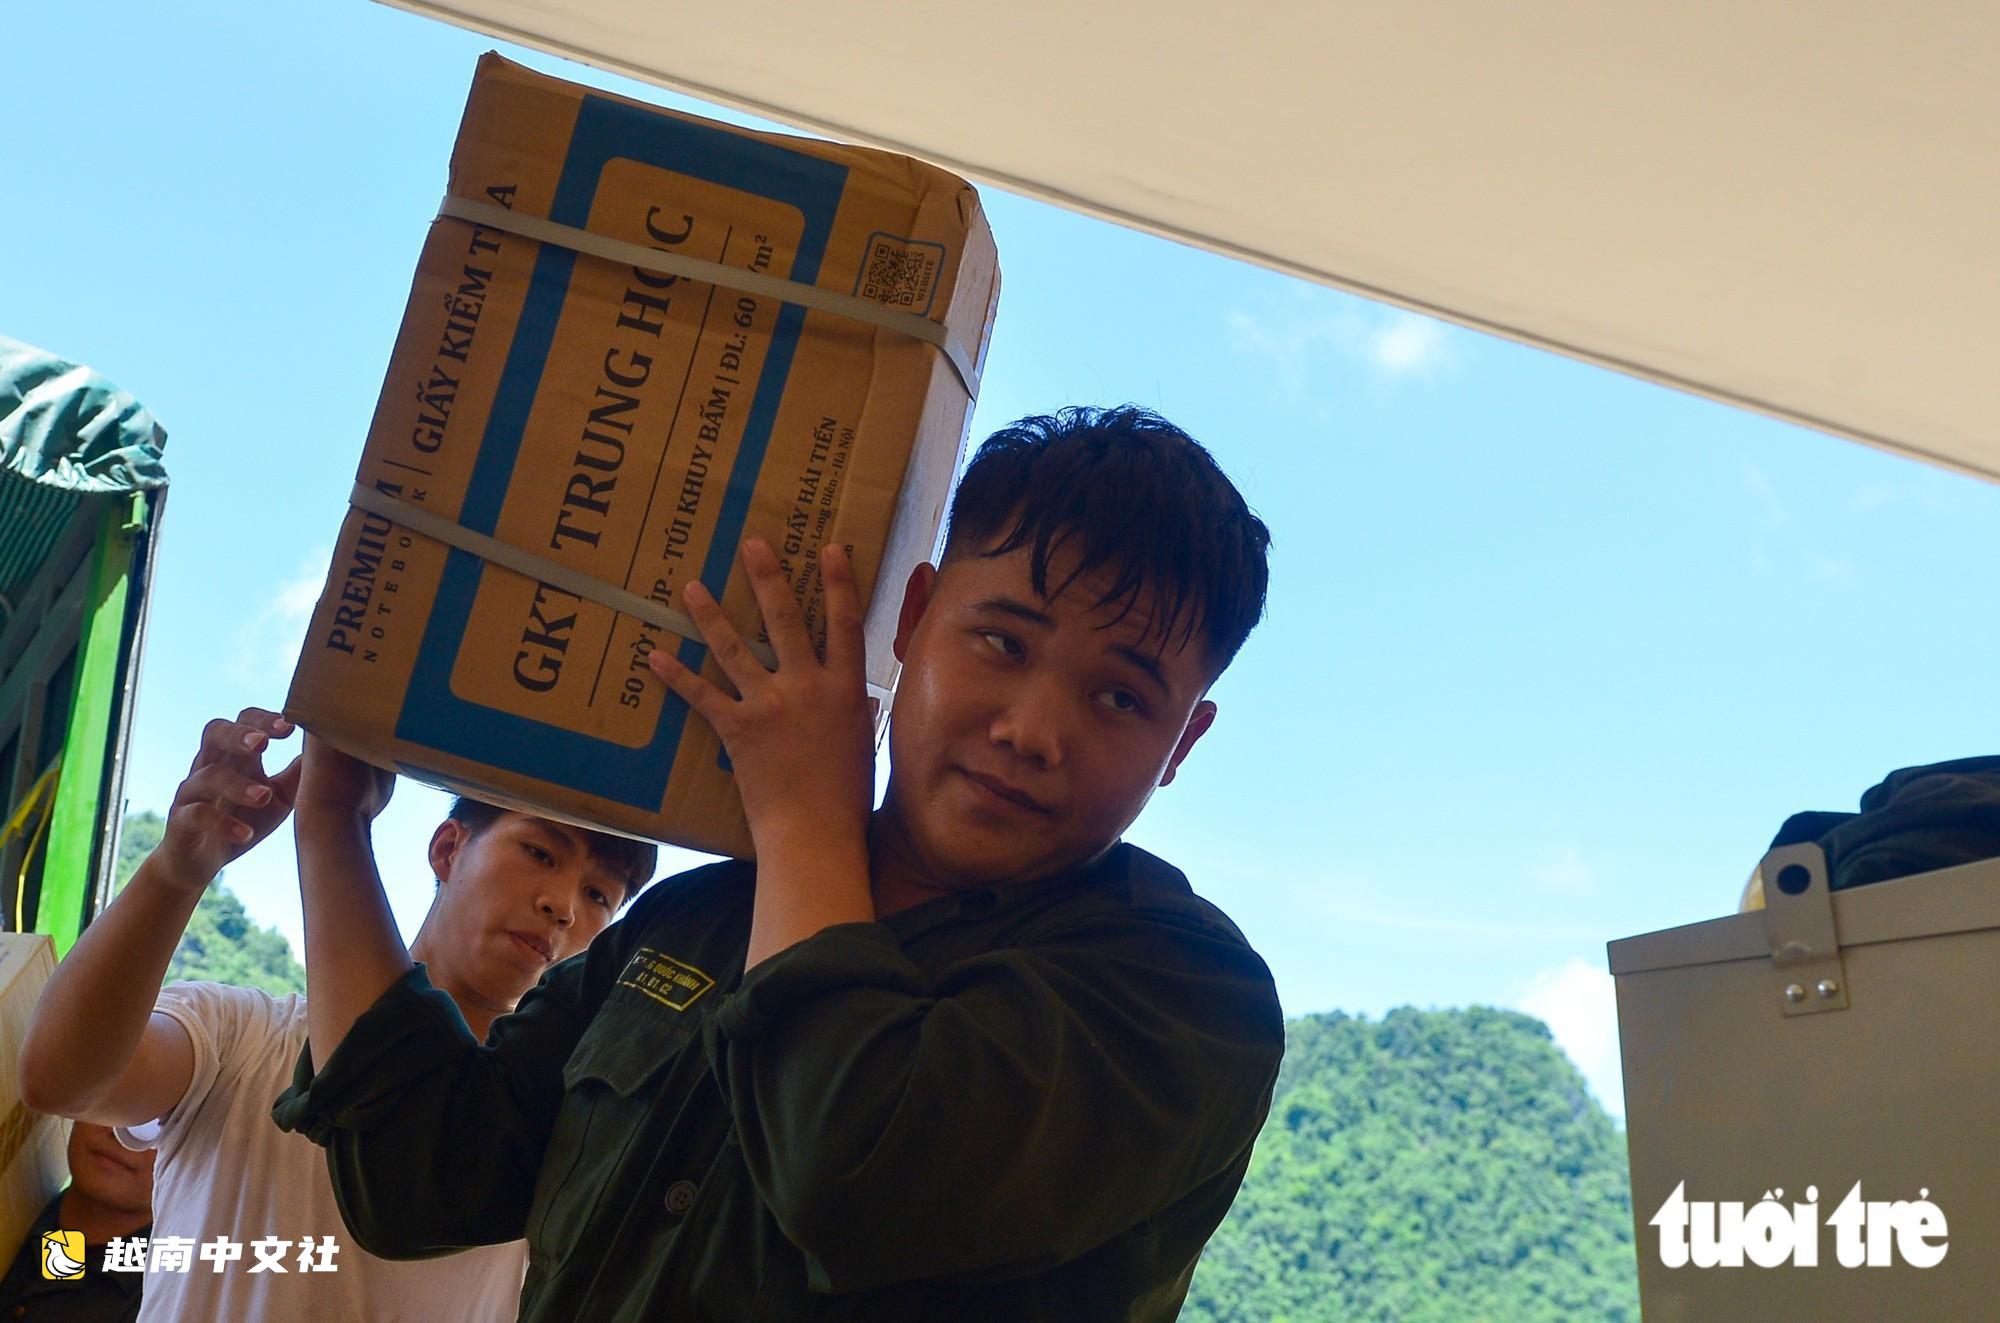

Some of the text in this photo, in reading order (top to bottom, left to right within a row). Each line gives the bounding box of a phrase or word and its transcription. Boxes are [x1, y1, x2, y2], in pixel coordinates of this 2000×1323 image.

[915, 260, 935, 301] WEBSITE
[412, 184, 517, 453] GIẤY KIỂM TA
[734, 297, 757, 329] 60
[720, 333, 748, 372] ĐL:
[698, 387, 730, 444] BẤM
[550, 348, 653, 550] TRUNG
[810, 416, 838, 464] TIẾN
[838, 428, 855, 450] Nội
[677, 444, 713, 517] KHUY
[830, 452, 847, 470] Hà
[798, 468, 823, 506] HẢI
[822, 478, 839, 507] Biên
[663, 518, 692, 560] TÚI
[784, 508, 809, 558] GIẤY
[812, 509, 832, 541] Long
[363, 488, 427, 663] NOTEBOK
[795, 563, 817, 596] Đồng
[630, 633, 656, 672] TỜ
[619, 677, 645, 709] 50
